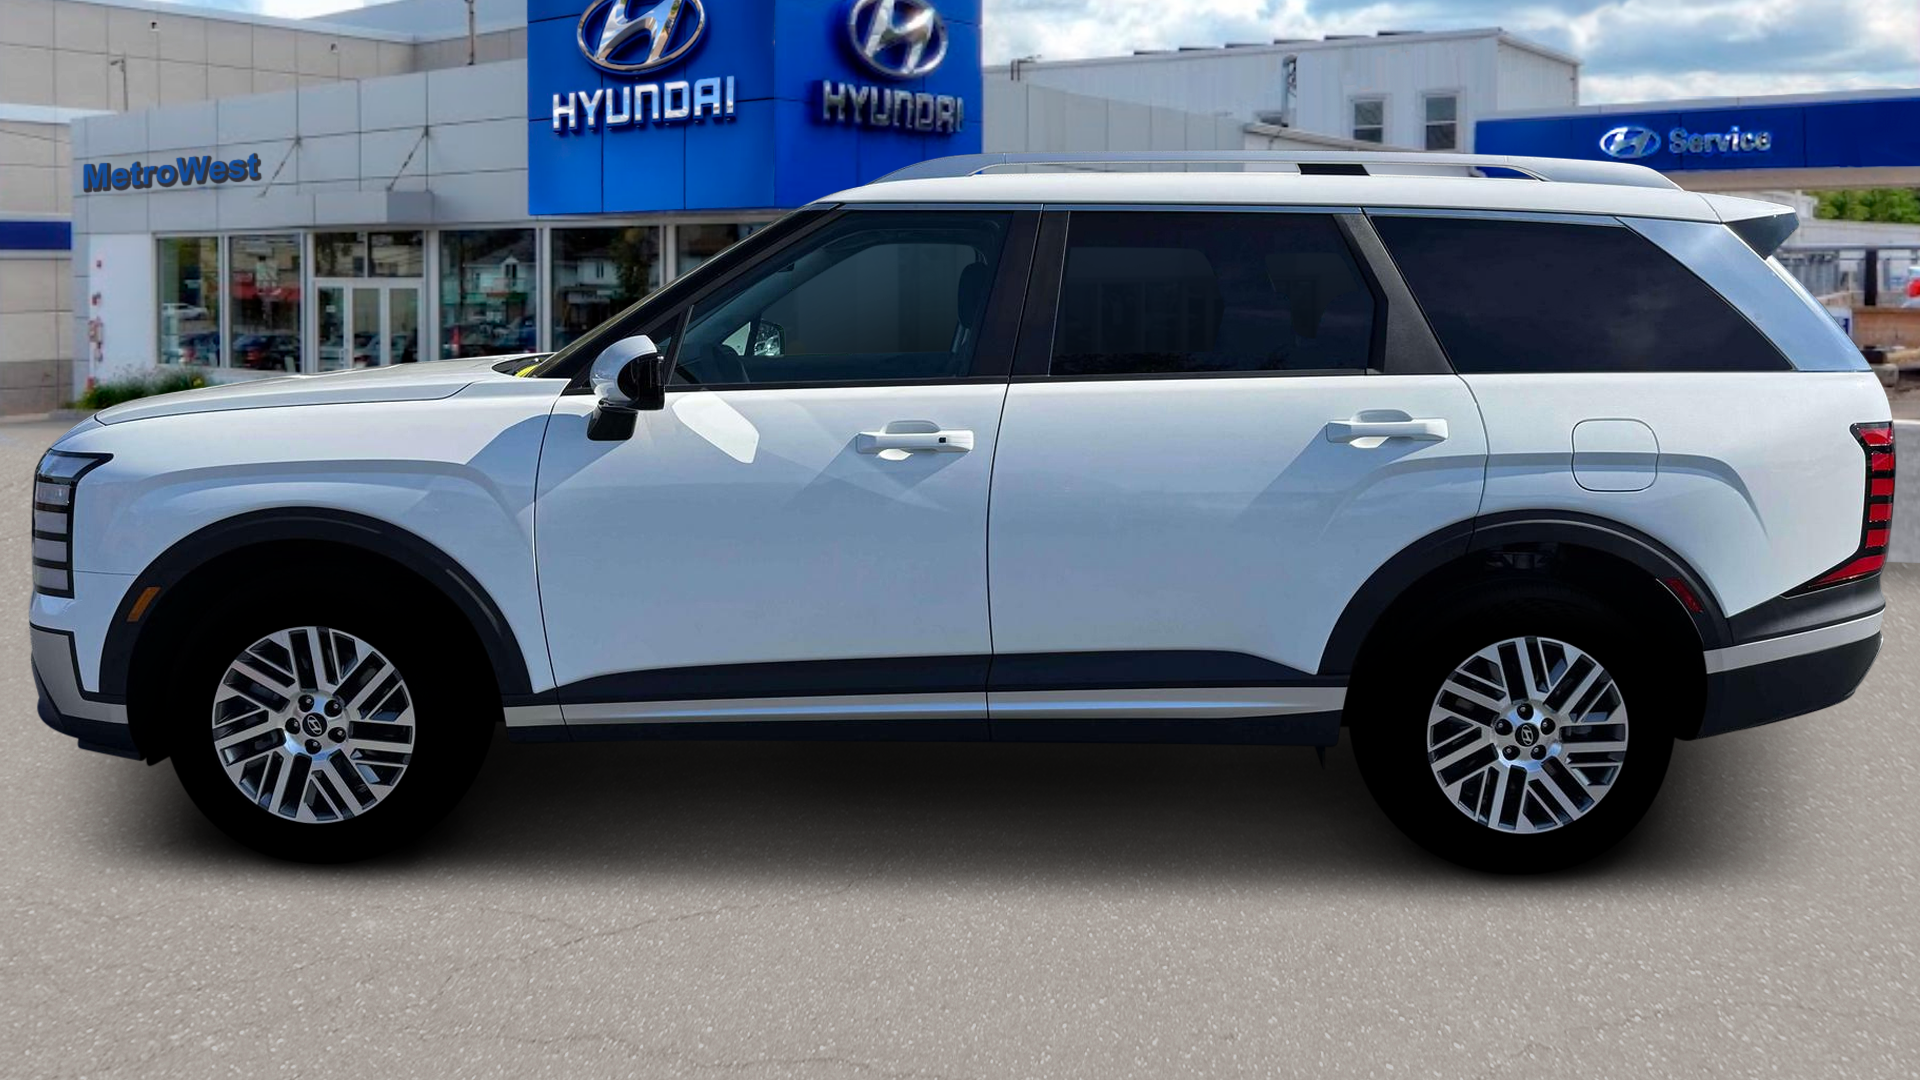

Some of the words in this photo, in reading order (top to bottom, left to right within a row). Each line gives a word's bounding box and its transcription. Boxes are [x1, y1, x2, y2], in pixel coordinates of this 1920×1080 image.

[553, 76, 734, 130] HYUNDAI
[823, 80, 964, 132] HYUNDAI
[1669, 126, 1771, 153] Service
[83, 153, 261, 192] MetroWest
